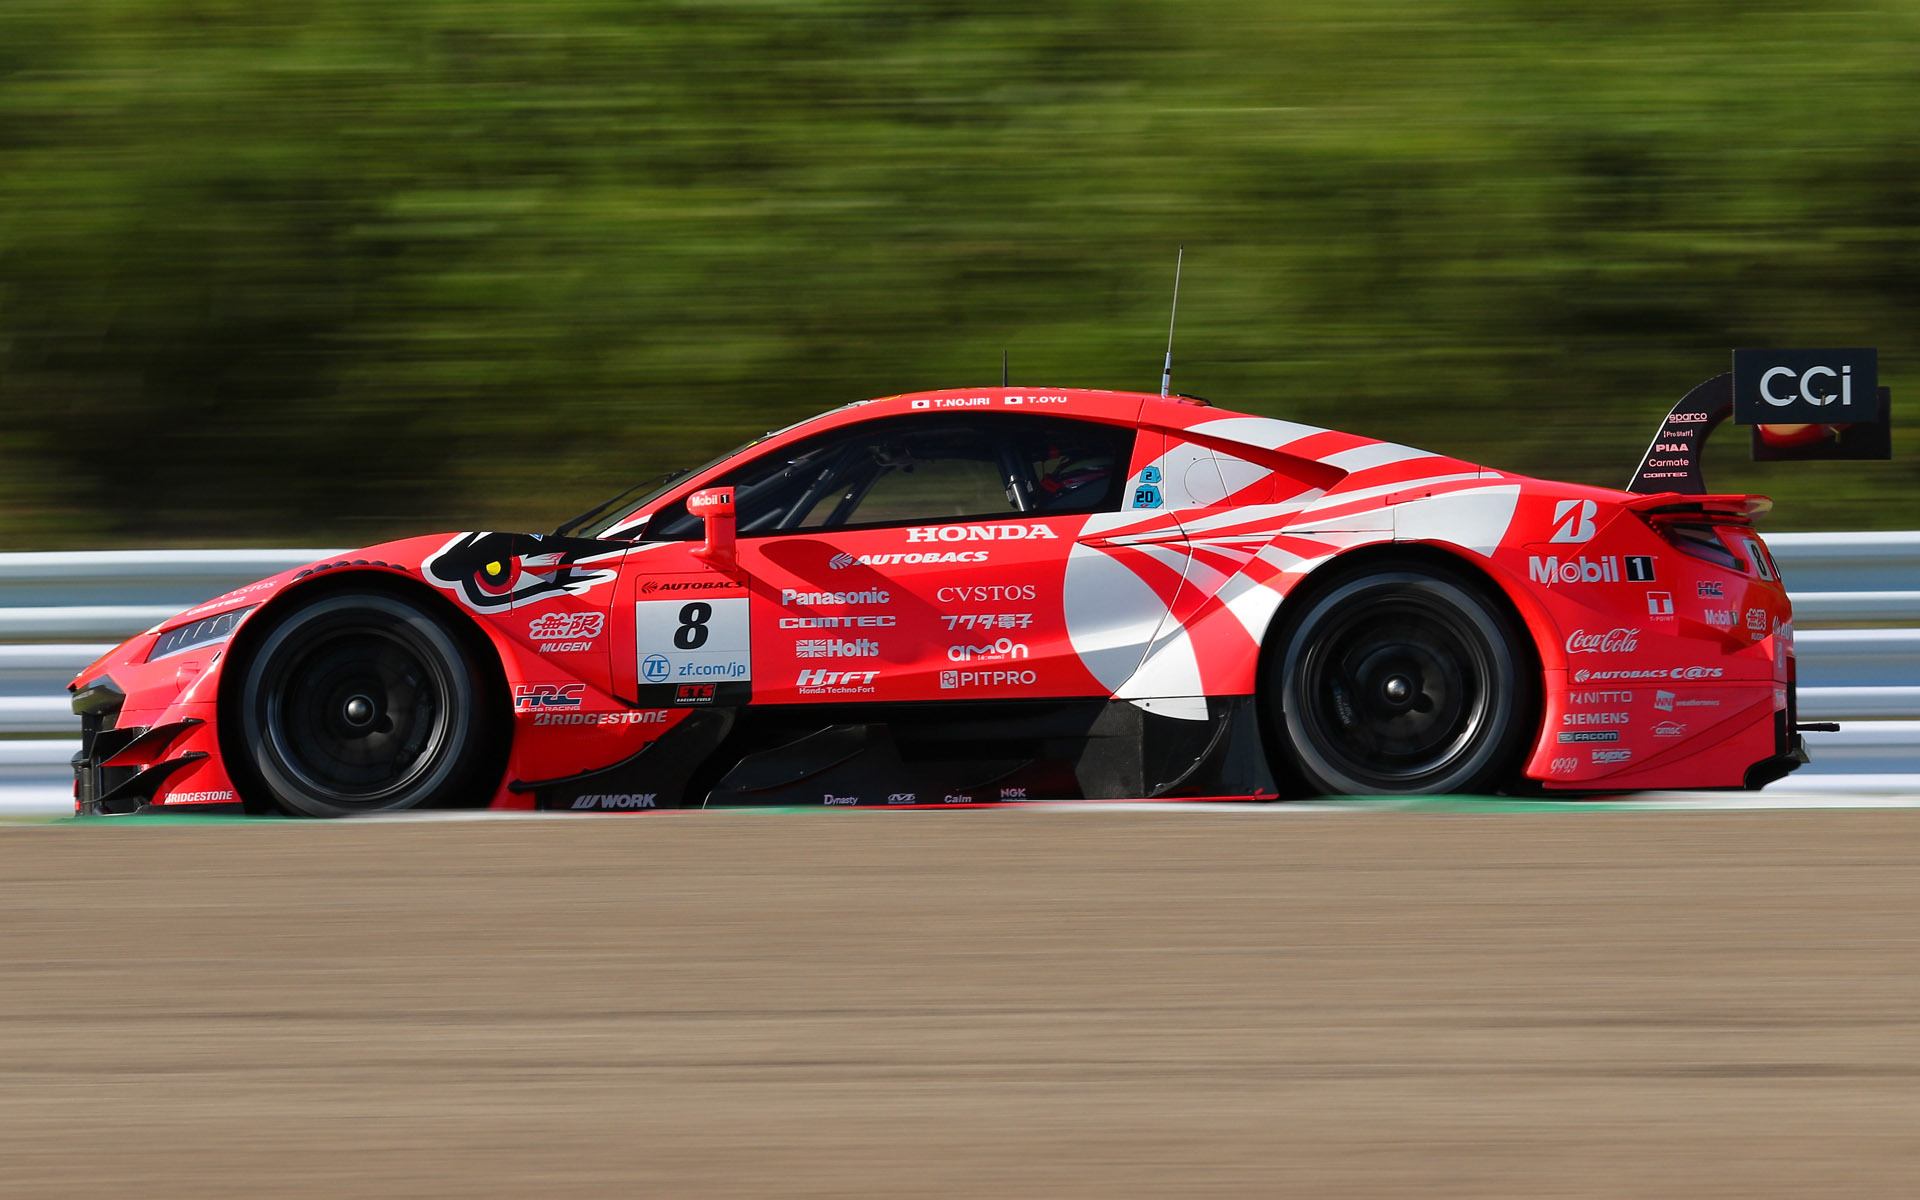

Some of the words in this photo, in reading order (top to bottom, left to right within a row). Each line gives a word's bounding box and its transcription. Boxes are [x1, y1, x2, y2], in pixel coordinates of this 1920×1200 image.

[1759, 365, 1851, 407] CCi
[934, 397, 990, 407] T.NOJIRI
[1669, 413, 1708, 423] sparco
[1655, 443, 1689, 452] PIAA
[1648, 458, 1689, 467] Carmate
[1145, 471, 1153, 481] 2
[692, 495, 718, 507] Mobil
[1136, 490, 1154, 503] 20
[906, 524, 1058, 543] HONDA
[852, 551, 989, 566] AUTOBACS
[1751, 544, 1768, 577] 8
[1528, 556, 1620, 584] Mobil
[659, 581, 744, 591] AUTOBACS
[781, 587, 890, 606] Panasonic
[936, 584, 1036, 603] CVSTOS
[1704, 610, 1731, 625] Mobil
[673, 602, 713, 651] 8
[539, 642, 592, 653] MUGEN
[827, 639, 879, 657] Holts
[679, 662, 746, 678] zf.com/jp
[1590, 669, 1667, 680] AUTOBACS
[796, 669, 880, 687] HTFT
[961, 670, 1036, 686] PITPRO
[515, 684, 586, 707] HRC
[678, 685, 715, 697] ETS
[1584, 691, 1632, 703] NITTO
[533, 710, 668, 725] BRIDGESTONE
[1563, 712, 1630, 725] SIEMENS
[164, 791, 233, 804] BRIDGESTONE
[944, 795, 972, 803] Calm
[1000, 788, 1026, 798] NGK
[601, 794, 657, 808] WORK
[823, 794, 858, 806] Dynasty
